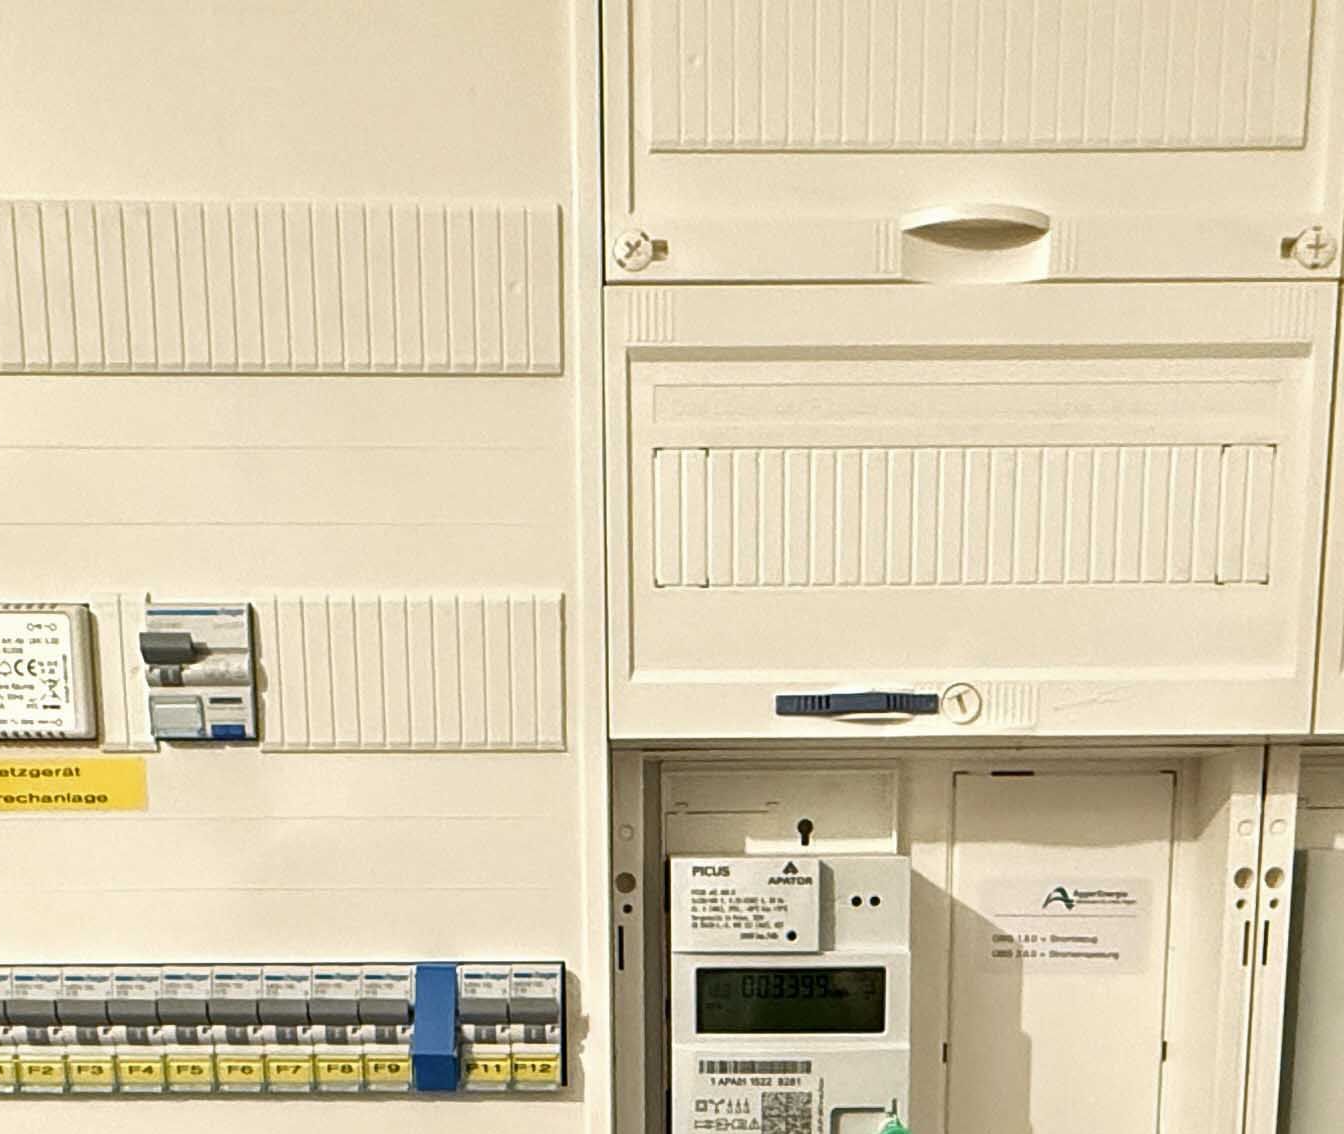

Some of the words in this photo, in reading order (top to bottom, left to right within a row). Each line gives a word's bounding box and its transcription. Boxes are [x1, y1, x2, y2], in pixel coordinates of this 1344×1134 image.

[692, 865, 731, 877] PICUS
[767, 876, 813, 886] APATOR
[27, 1064, 54, 1076] F2
[76, 1064, 104, 1076] F3
[128, 1064, 154, 1076] F4
[176, 1064, 204, 1076] F5
[227, 1064, 254, 1076] F6
[276, 1064, 302, 1075] F7
[326, 1064, 353, 1075] F8
[373, 1063, 401, 1074] F9
[466, 1063, 502, 1075] F11
[514, 1063, 552, 1074] F12
